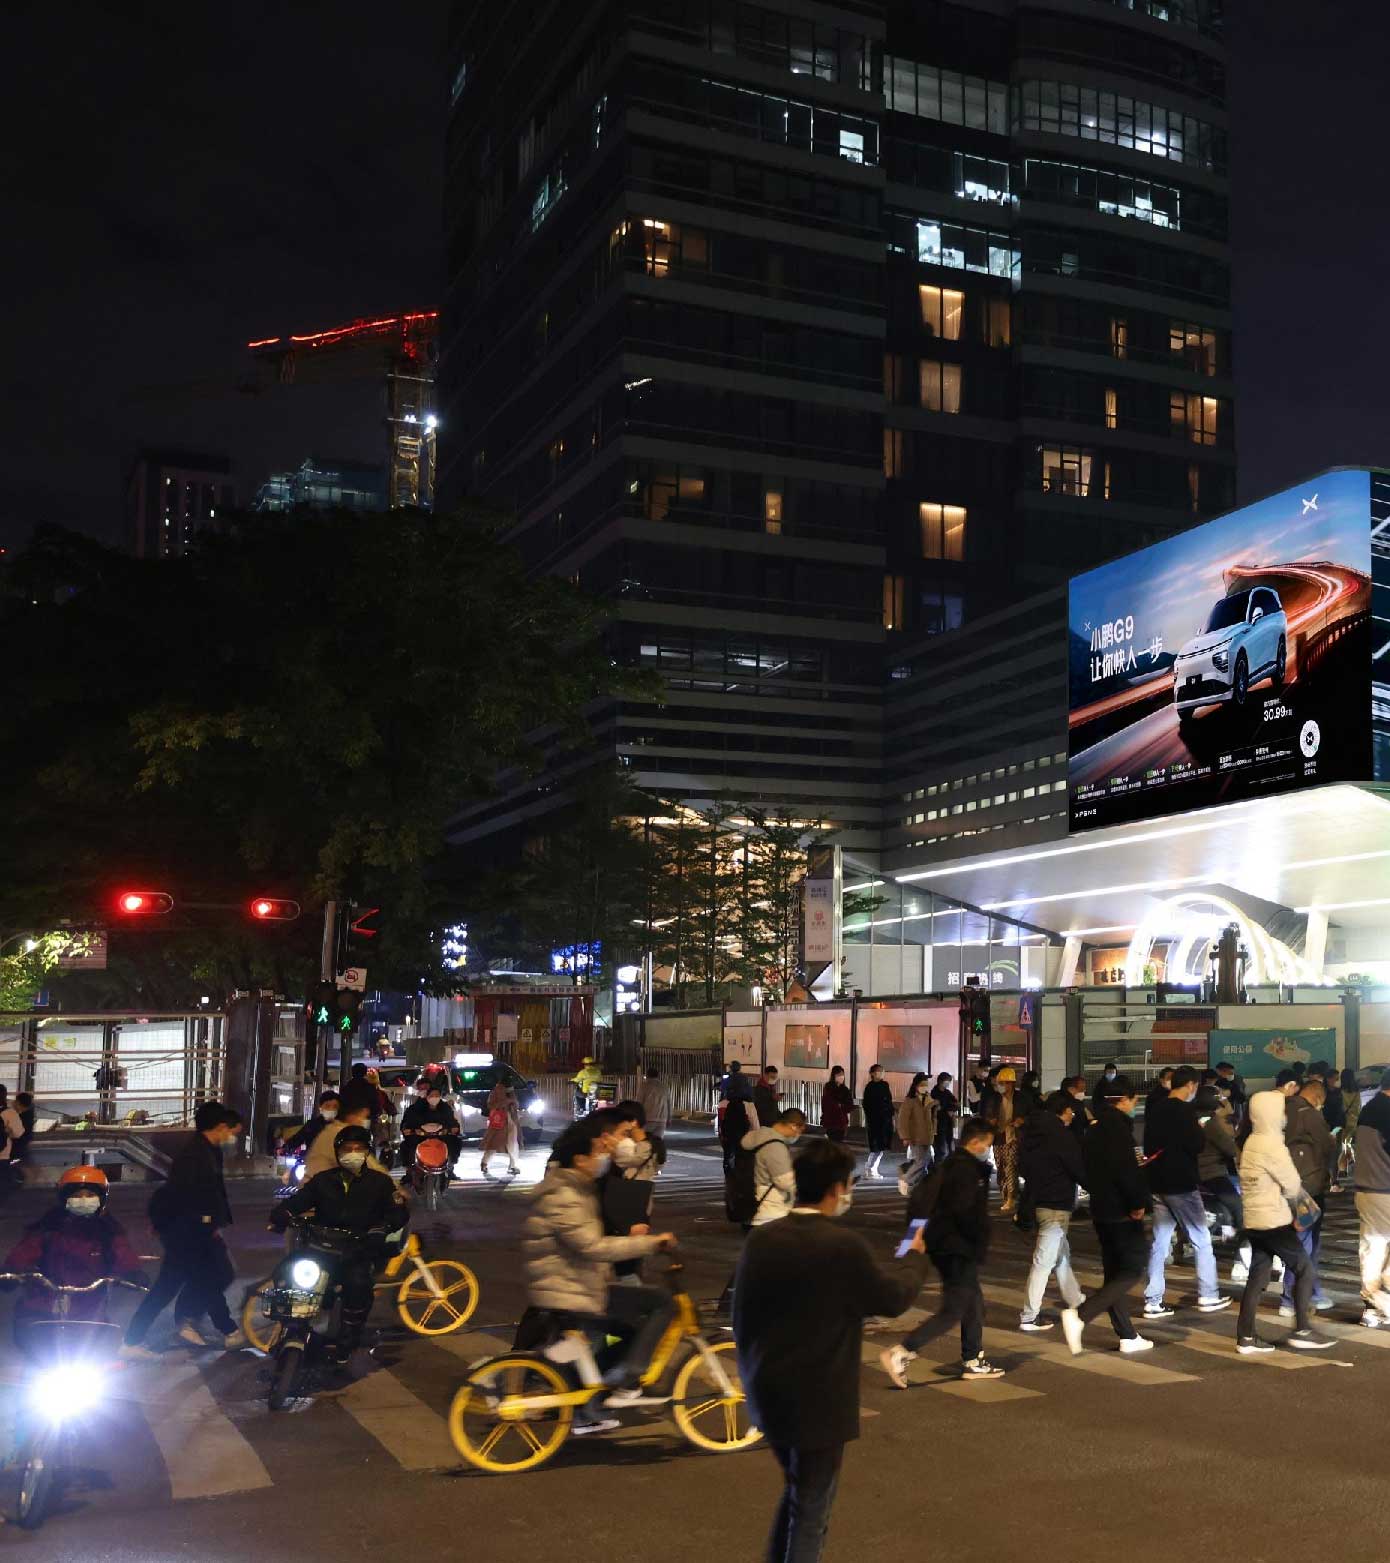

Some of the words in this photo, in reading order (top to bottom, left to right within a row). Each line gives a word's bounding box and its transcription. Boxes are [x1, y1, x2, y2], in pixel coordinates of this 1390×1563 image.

[1090, 615, 1134, 652] 小鹏G9
[1090, 635, 1163, 683] 让你快人一步
